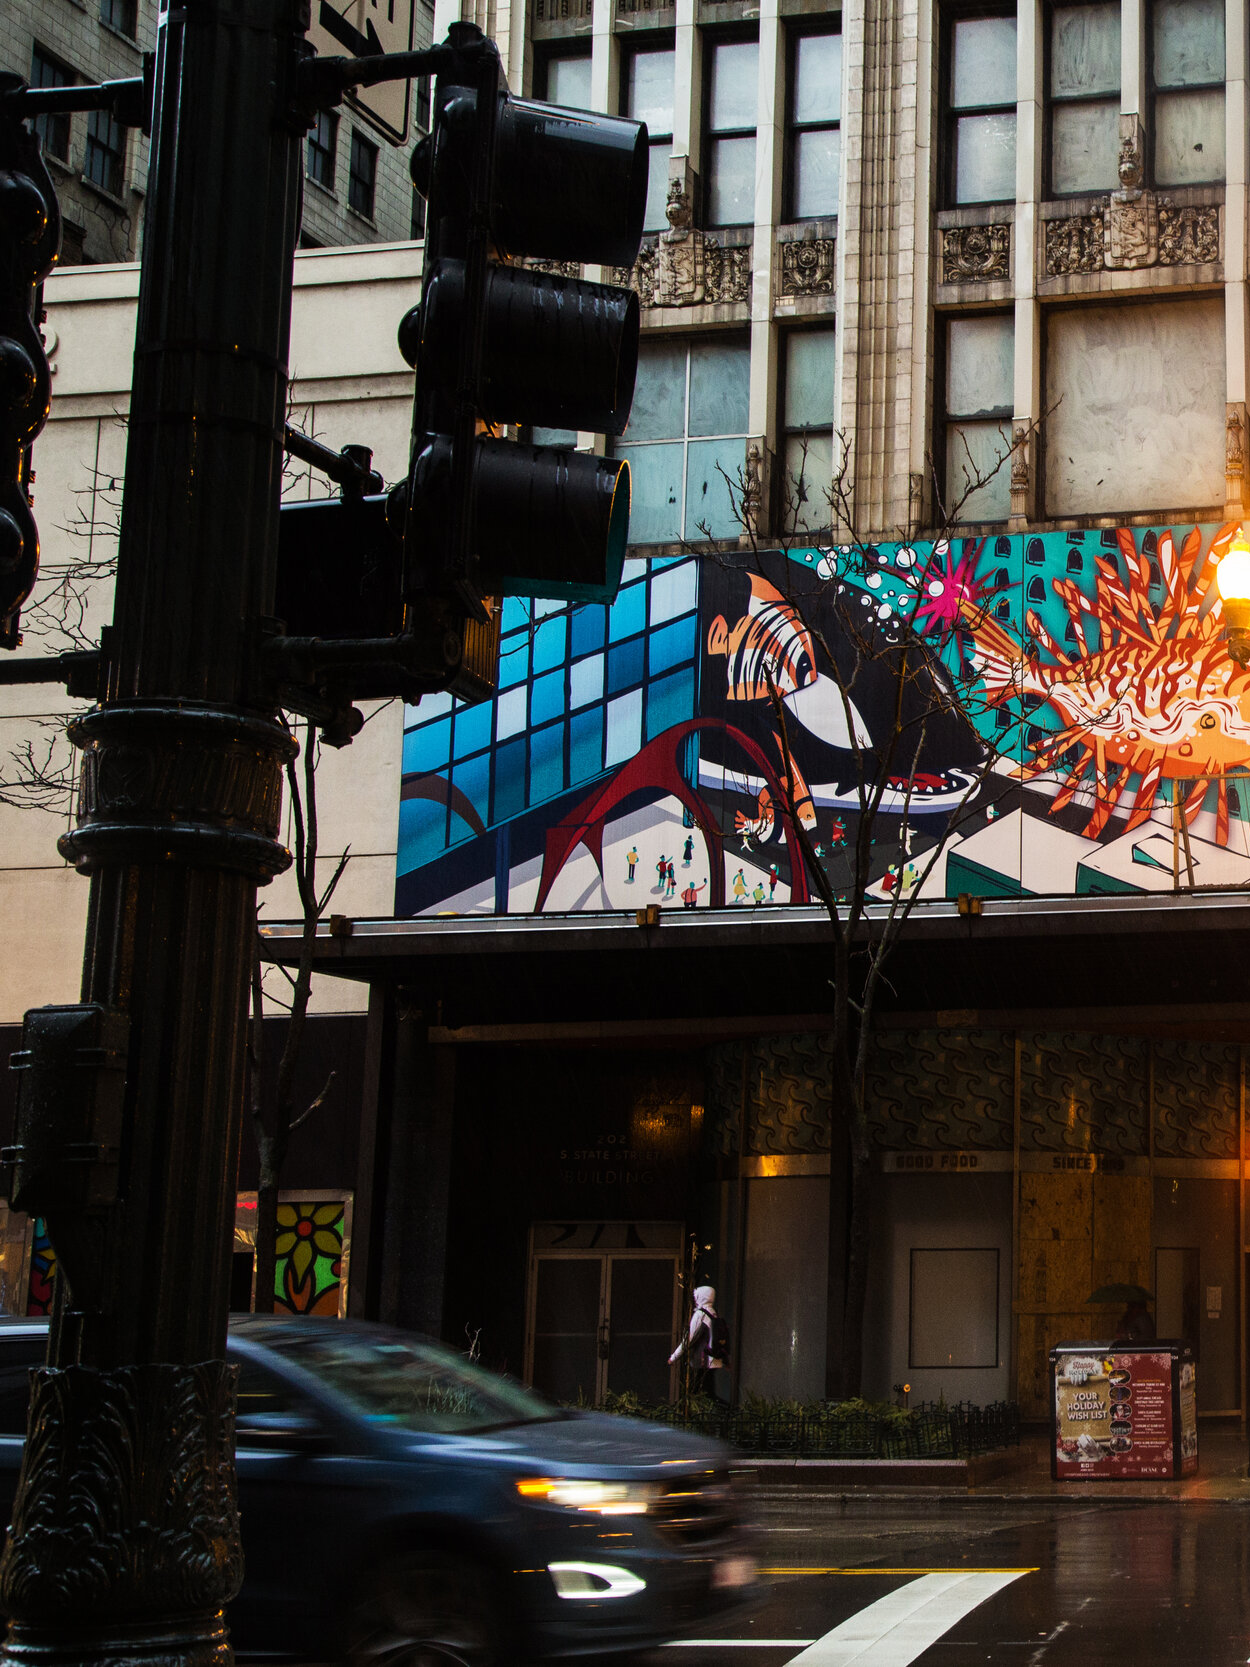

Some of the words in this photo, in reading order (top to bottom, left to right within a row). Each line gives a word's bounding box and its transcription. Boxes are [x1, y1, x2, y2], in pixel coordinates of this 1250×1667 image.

[573, 1150, 610, 1160] STATE
[615, 1150, 661, 1160] STREET
[941, 1154, 978, 1168] FOOD
[1053, 1157, 1091, 1169] SINCE
[564, 1170, 655, 1185] BUILDING
[1072, 1392, 1098, 1401] YOUR
[1067, 1401, 1104, 1411] HOLIDAY
[1067, 1411, 1090, 1420] WISH
[1091, 1410, 1108, 1419] LIST
